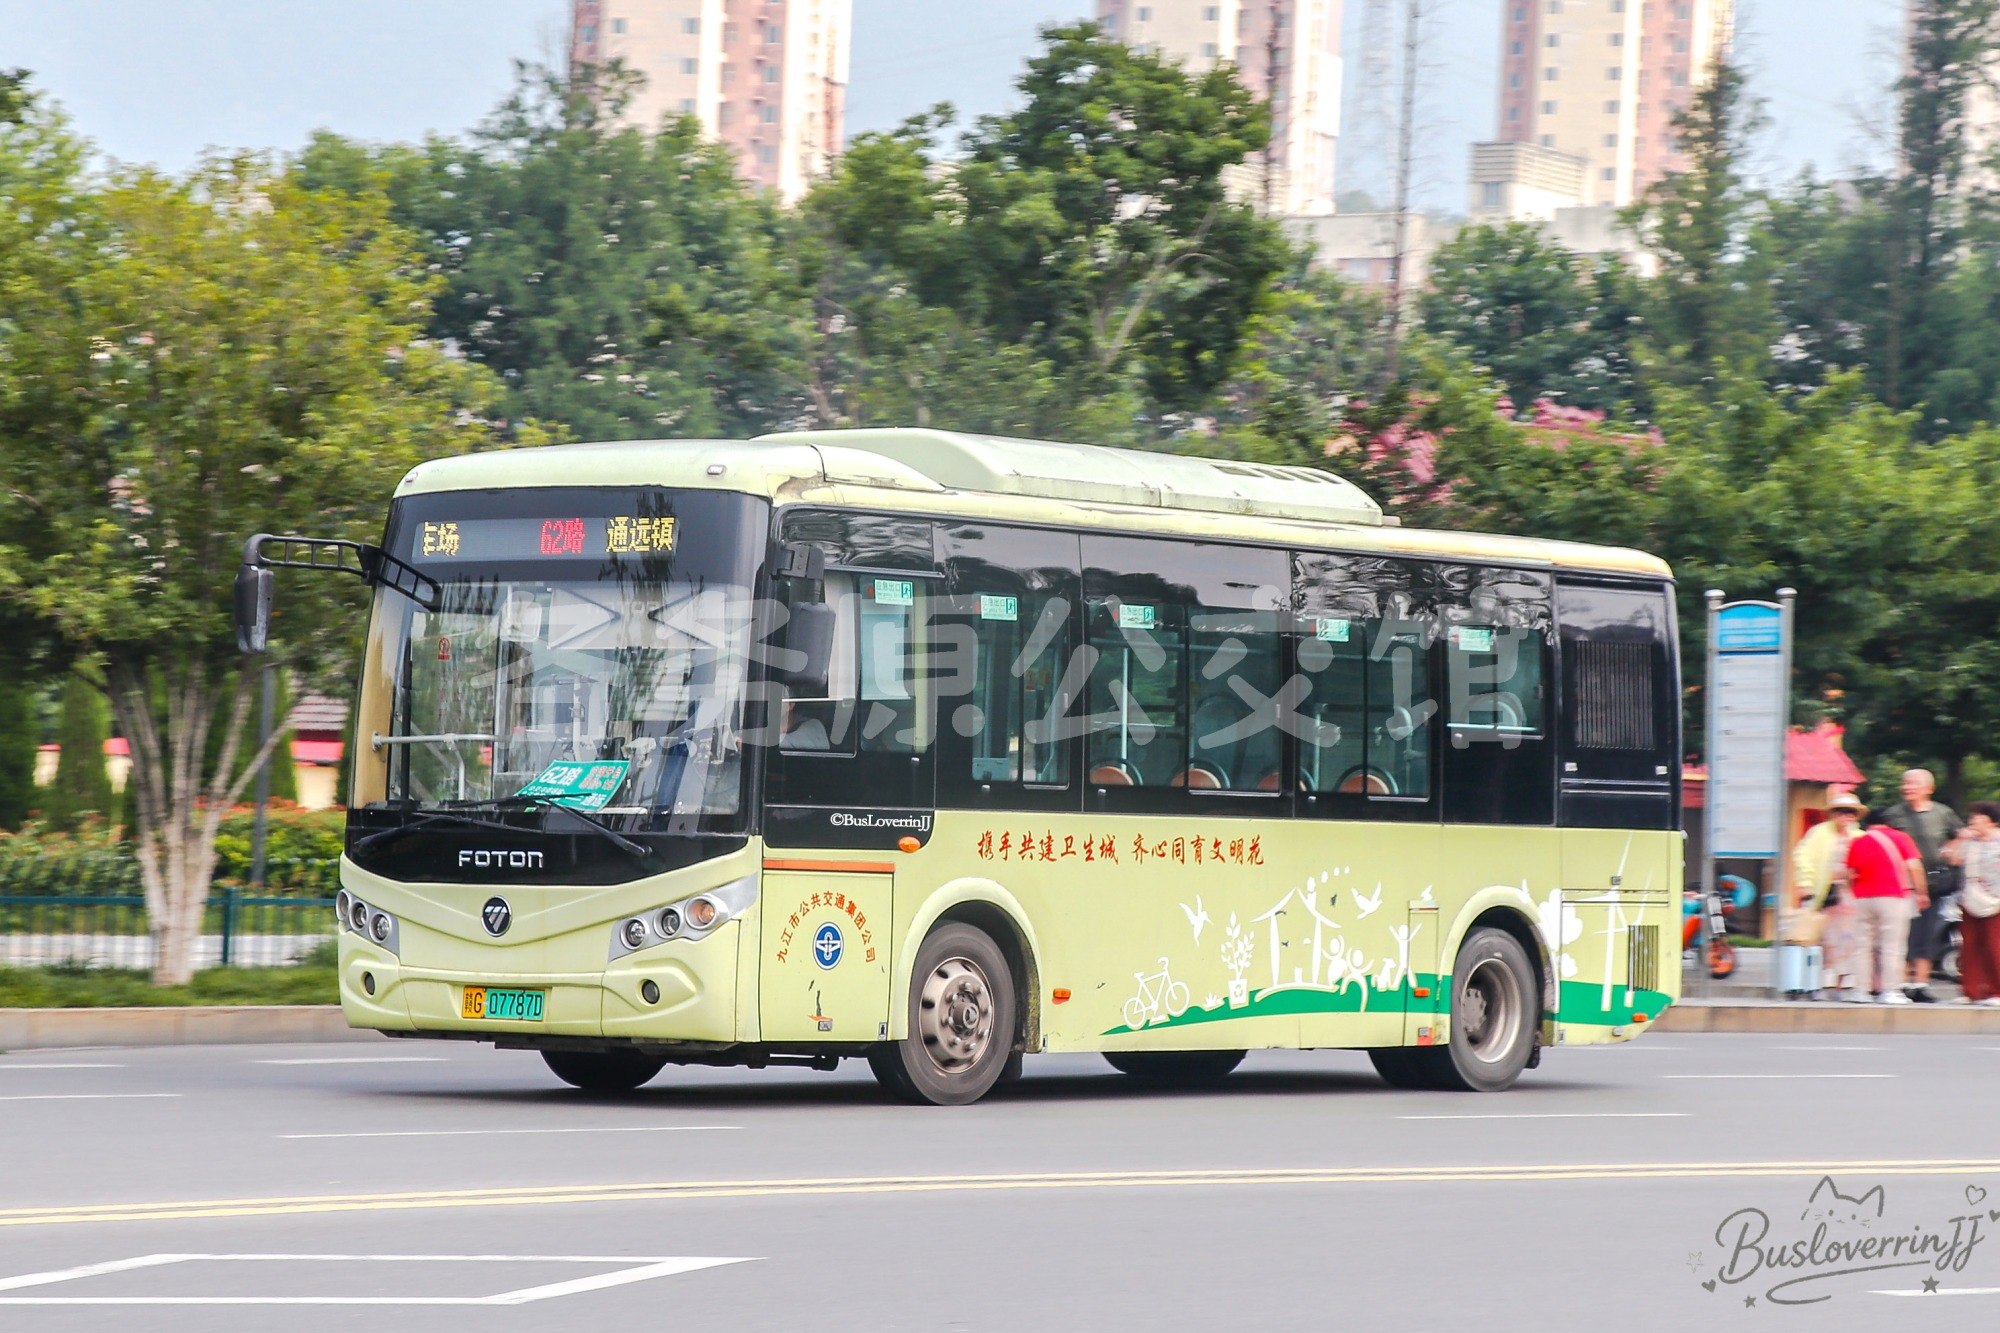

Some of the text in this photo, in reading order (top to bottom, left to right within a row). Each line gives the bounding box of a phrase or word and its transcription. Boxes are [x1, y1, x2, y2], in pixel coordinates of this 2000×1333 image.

[540, 517, 585, 554] 62路
[606, 516, 675, 552] 通远镇
[459, 850, 543, 868] FOTON
[977, 829, 1265, 865] 携手共建卫生城 齐心同育文明花
[776, 890, 876, 963] 九江市公共交通集团公司
